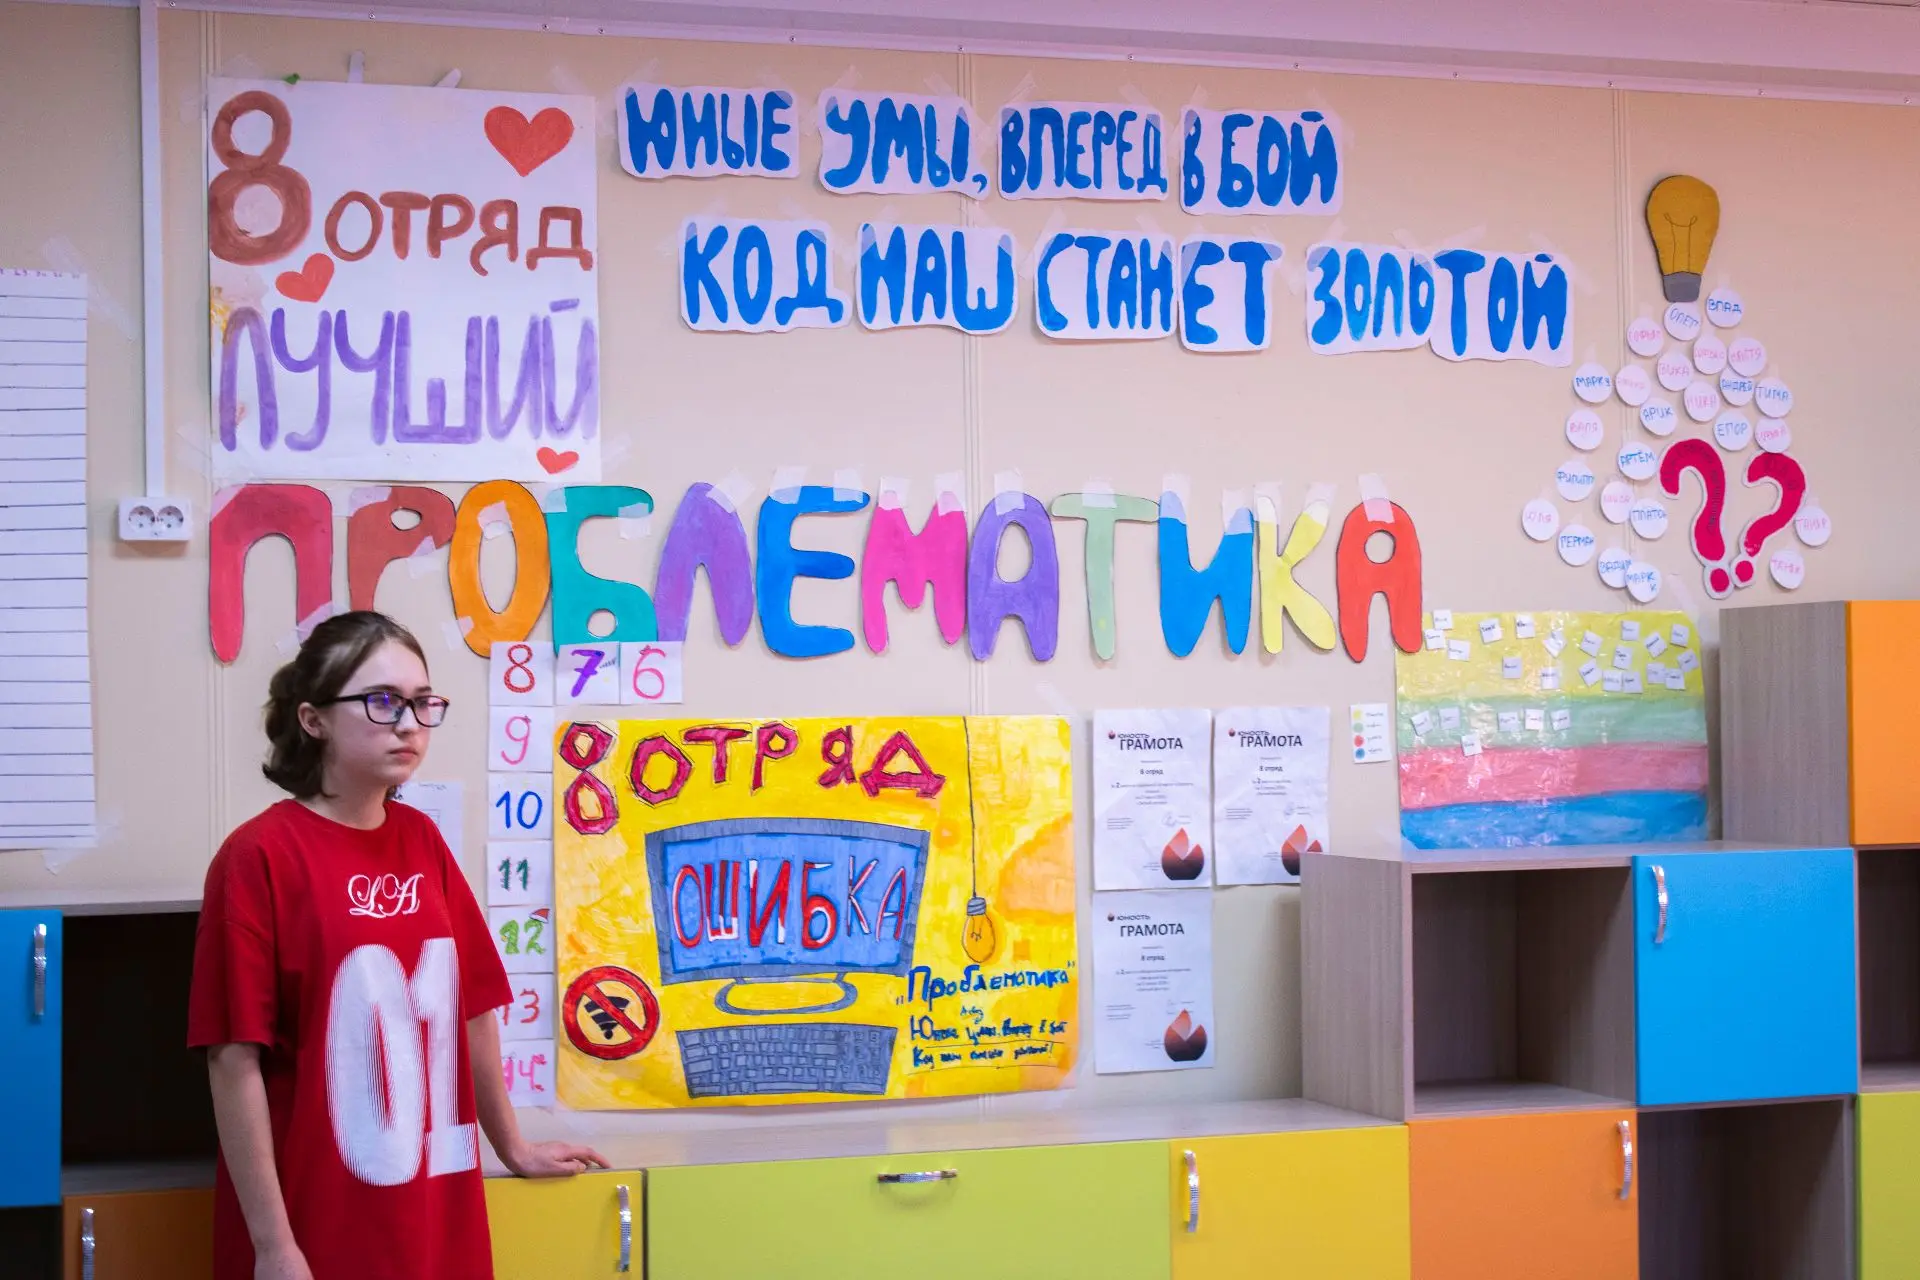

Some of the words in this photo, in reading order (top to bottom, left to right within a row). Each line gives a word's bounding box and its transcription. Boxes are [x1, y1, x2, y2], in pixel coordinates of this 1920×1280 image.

[207, 90, 311, 265] 8
[325, 191, 592, 275] ОТРЯД
[625, 88, 791, 173] ЮНЫЕ
[824, 97, 989, 193] УМЫ,
[1000, 107, 1167, 194] ВПЕРЕД
[1180, 111, 1202, 208] В
[1217, 110, 1338, 207] БОЙ
[683, 222, 844, 326] КОД
[857, 223, 1015, 331] НАШ
[1035, 233, 1282, 346] СТАНЕТ
[1306, 246, 1567, 356] ЗОЛОТОЙ
[1707, 299, 1742, 314] ВЛАД
[219, 298, 597, 451] ЛУЧШИЙ
[209, 478, 1424, 664] ПРОБЛЕМАТИКА
[504, 644, 535, 693] 8
[570, 649, 605, 698] 7
[632, 645, 666, 699] 6
[501, 715, 531, 765] 9
[1120, 738, 1183, 750] ГРАМОТА
[1240, 736, 1303, 748] ГРАМОТА
[496, 791, 543, 829] 10
[559, 721, 620, 835] 8
[626, 722, 946, 808] ОТРЯД
[499, 857, 530, 891] 11
[672, 855, 906, 950] ОШИБКА
[1120, 923, 1185, 937] ГРАМОТА
[325, 937, 478, 1187] 01
